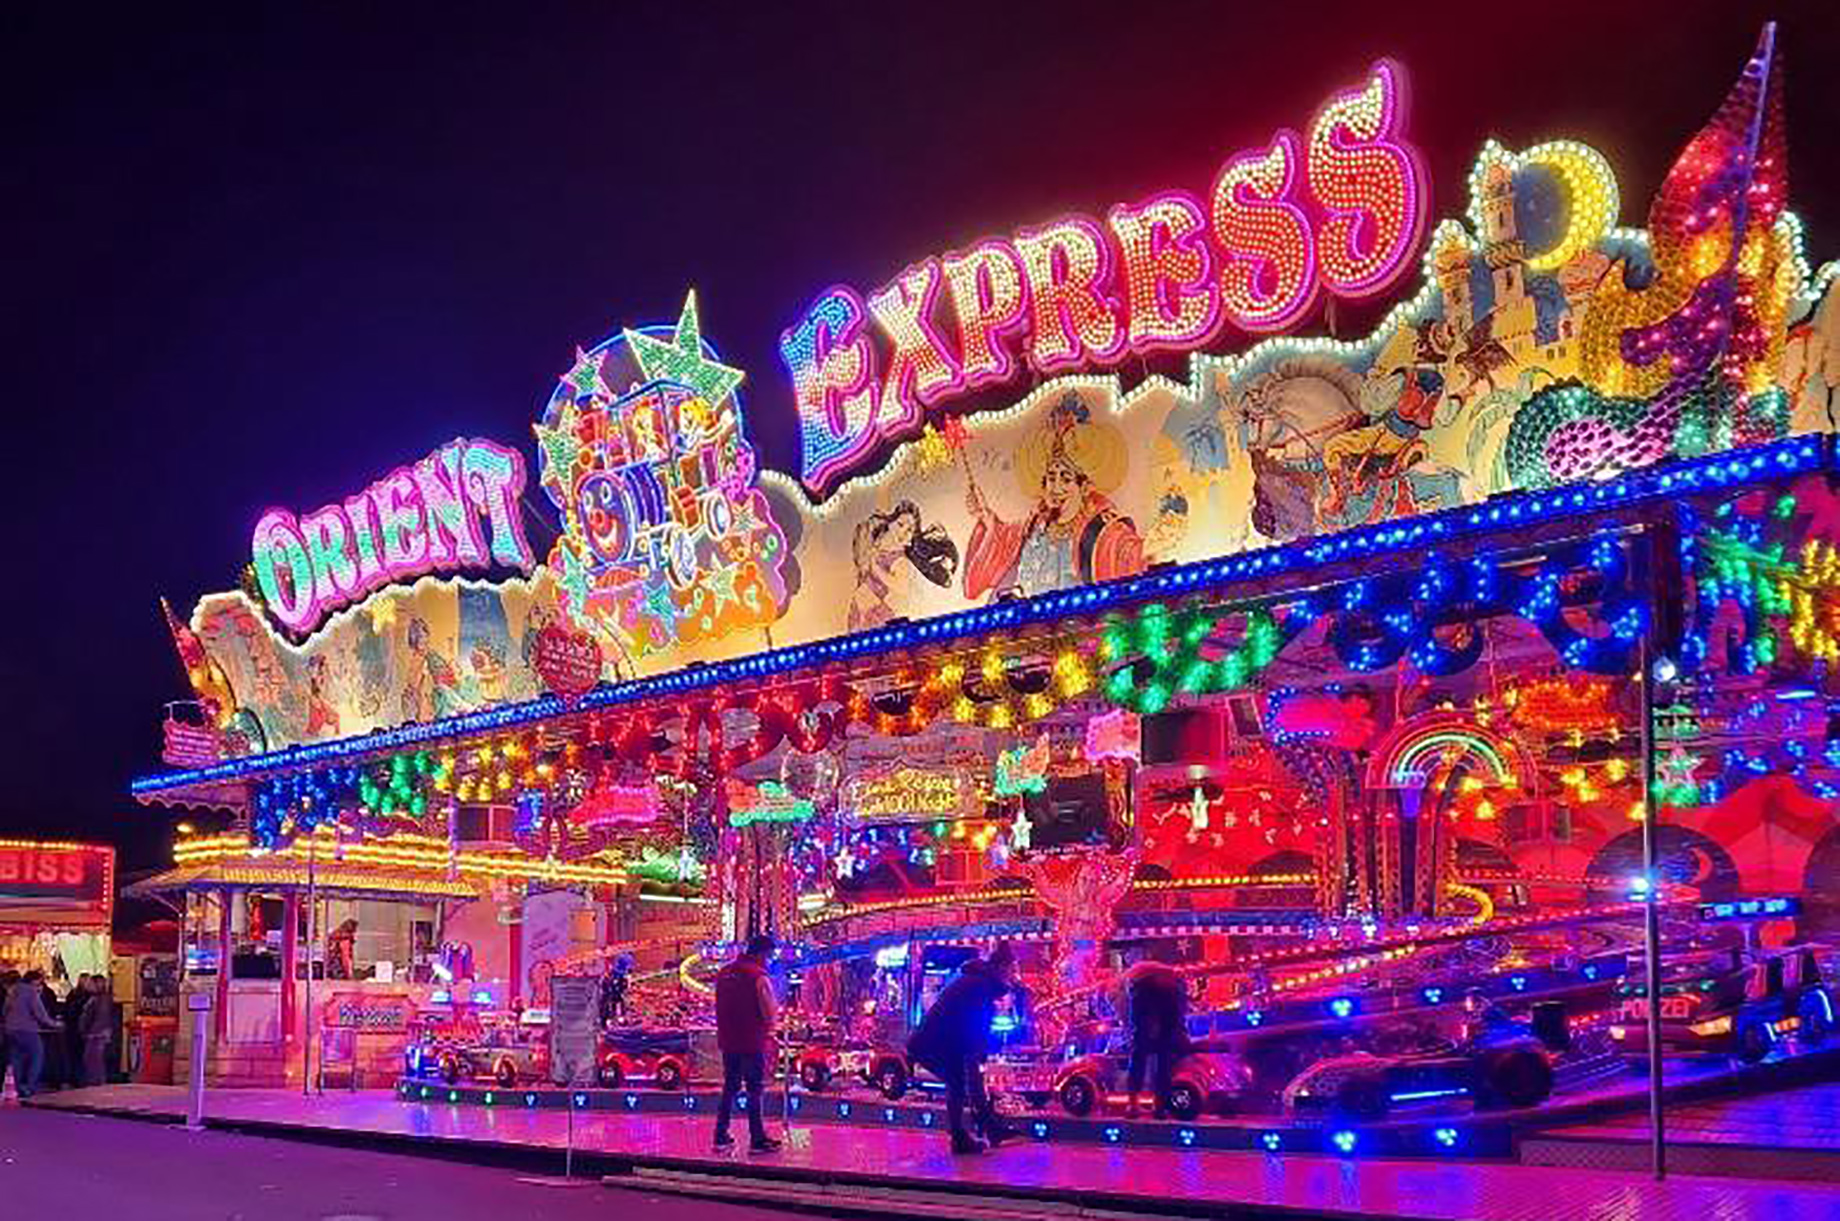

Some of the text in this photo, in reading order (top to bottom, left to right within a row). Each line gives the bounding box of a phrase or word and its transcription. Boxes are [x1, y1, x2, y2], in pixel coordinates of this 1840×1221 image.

[252, 59, 1424, 634] ORIENT EXPRESS
[1622, 997, 1690, 1019] POLZEI
